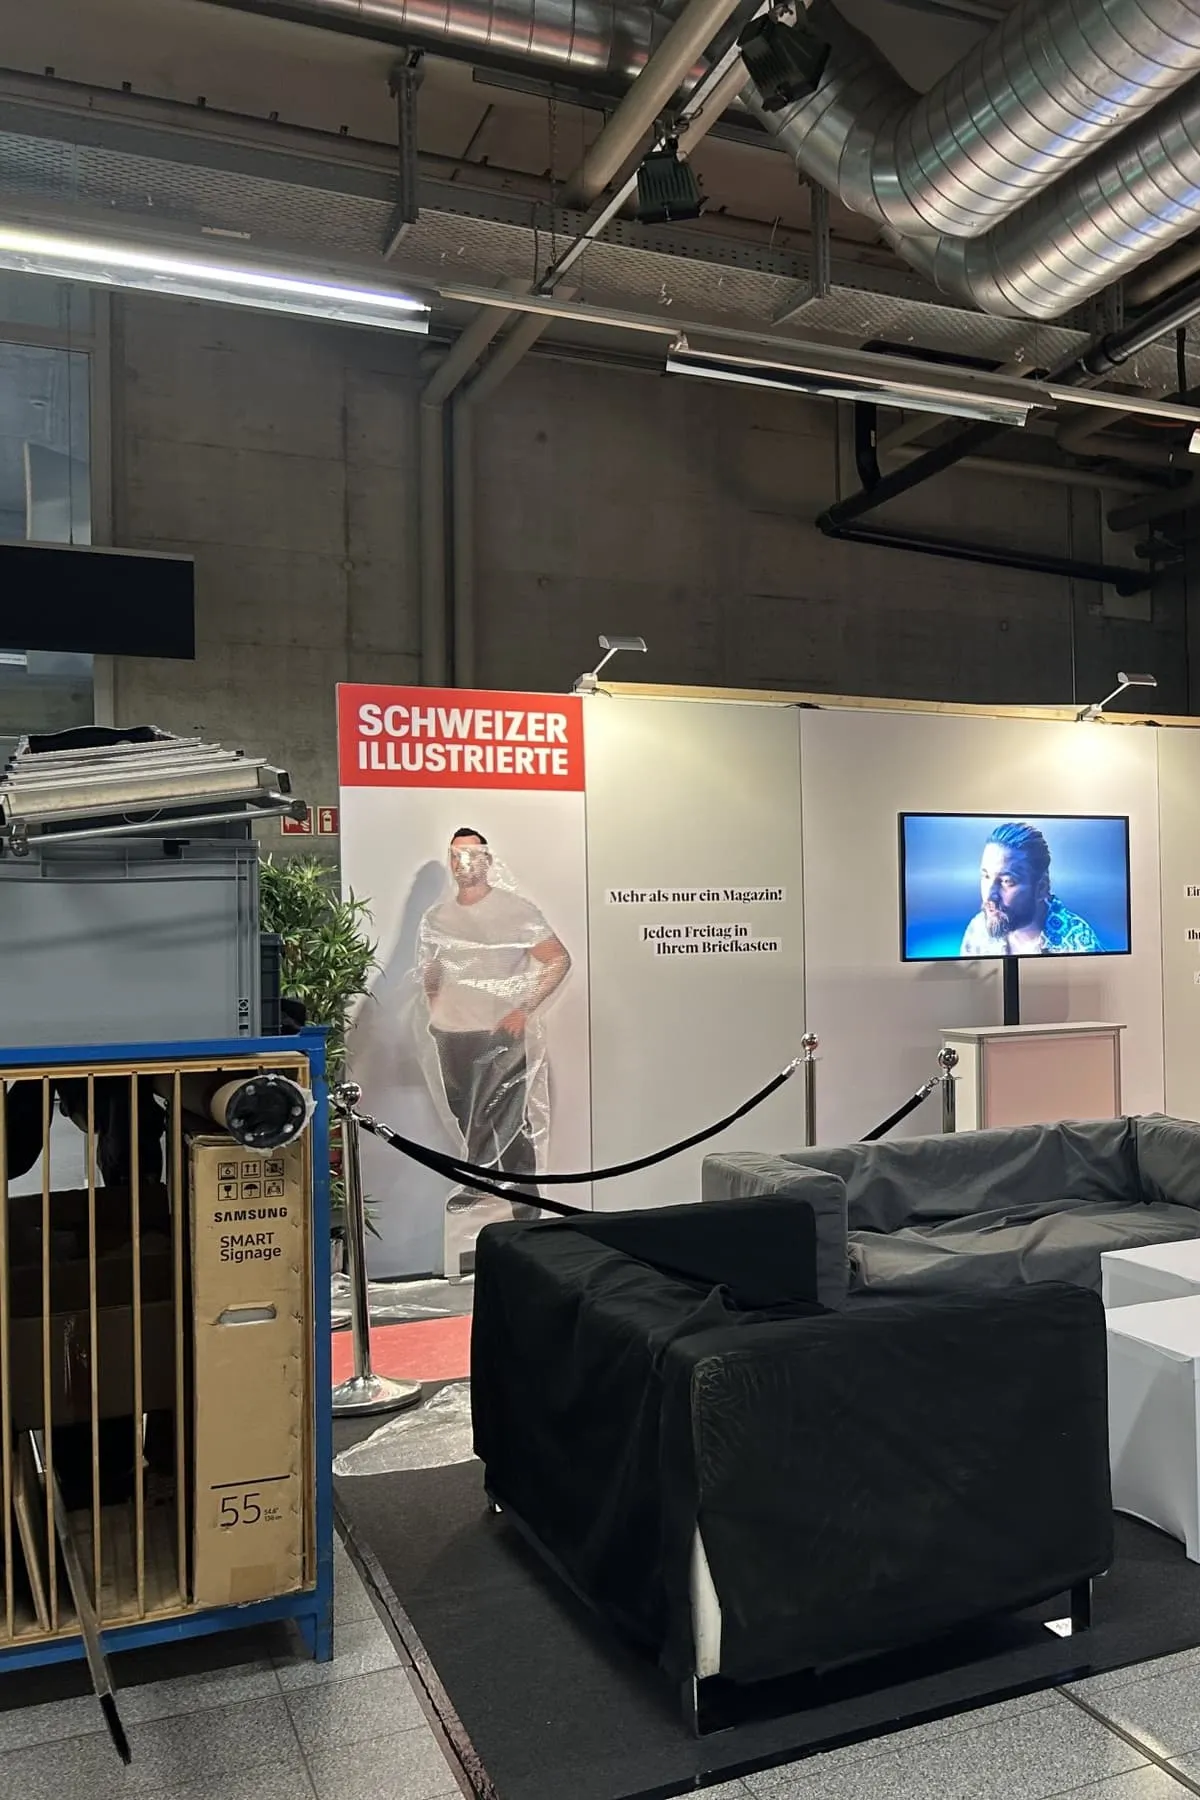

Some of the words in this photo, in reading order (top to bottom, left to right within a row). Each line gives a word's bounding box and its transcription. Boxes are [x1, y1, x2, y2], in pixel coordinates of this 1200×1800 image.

[358, 704, 568, 743] SCHWEIZER
[358, 741, 568, 775] ILLUSTRIERTE
[610, 890, 646, 903] Mehr
[648, 889, 669, 902] als
[672, 891, 697, 902] nur
[699, 889, 720, 901] ein
[723, 889, 782, 904] Magazin!
[643, 926, 681, 941] Jeden
[685, 925, 733, 940] Freitag
[734, 924, 748, 937] in
[657, 942, 699, 954] Ihrem
[702, 940, 777, 953] Briefkasten
[214, 1207, 288, 1222] SAMSUNG
[220, 1232, 275, 1248] SMART
[220, 1247, 281, 1263] Signage
[220, 1493, 261, 1527] 55
